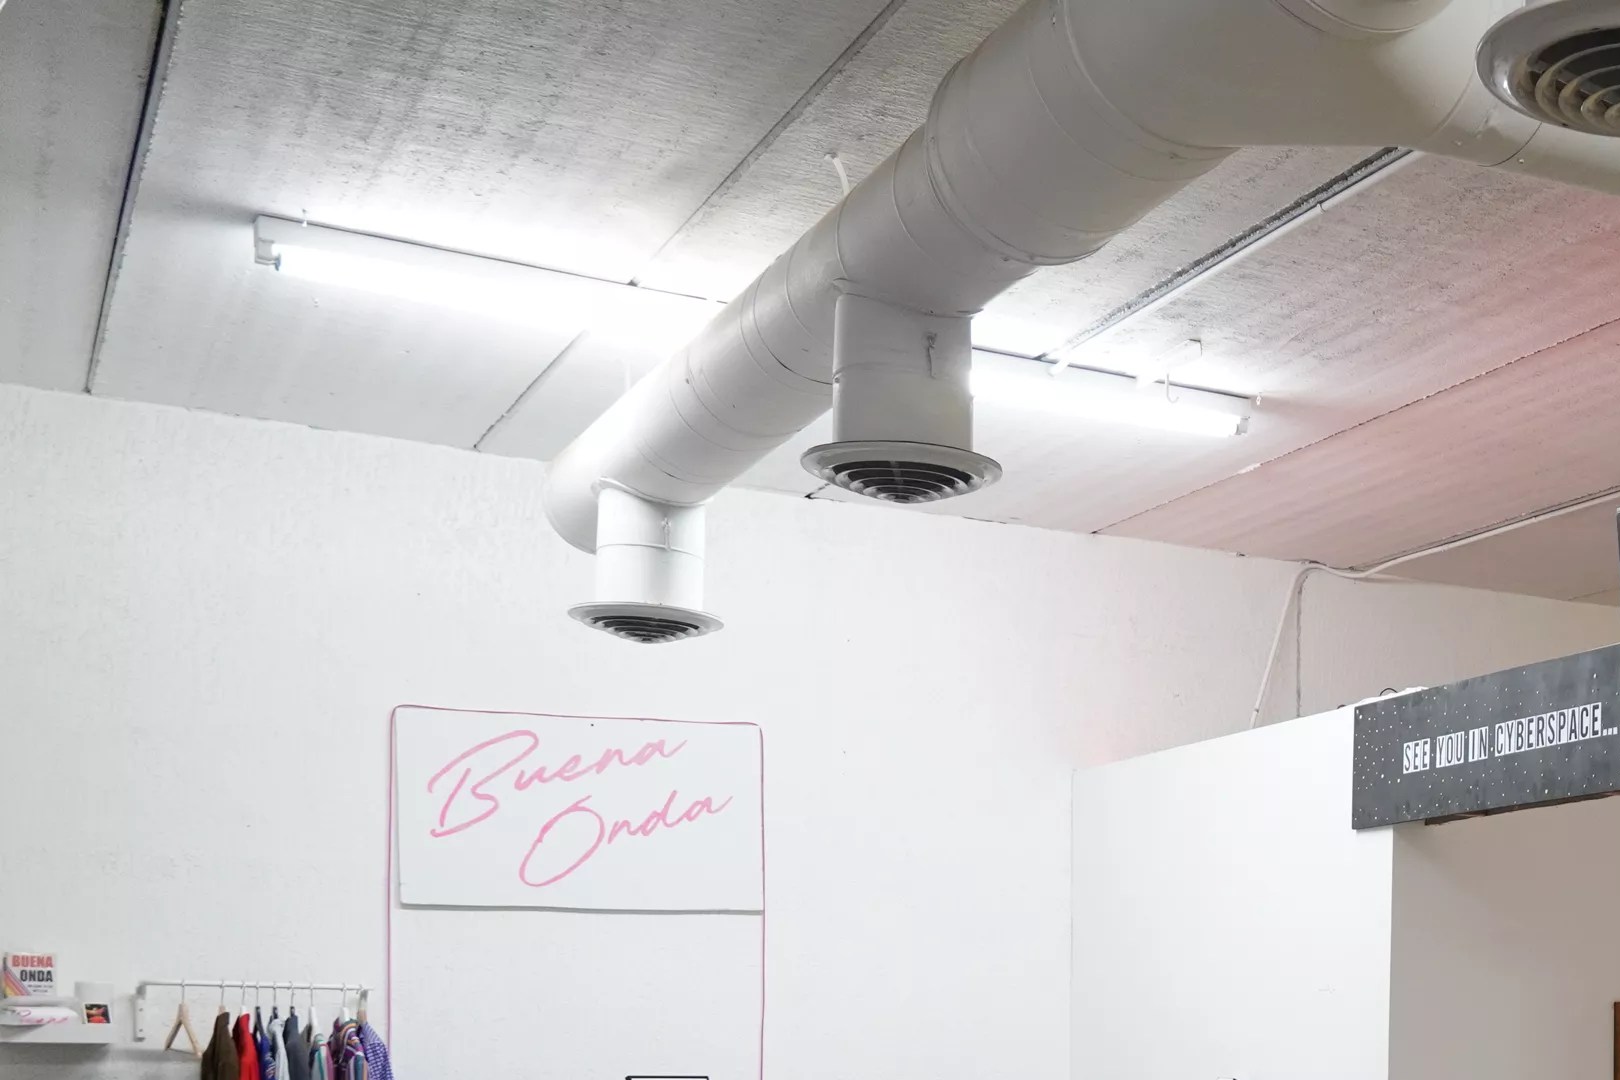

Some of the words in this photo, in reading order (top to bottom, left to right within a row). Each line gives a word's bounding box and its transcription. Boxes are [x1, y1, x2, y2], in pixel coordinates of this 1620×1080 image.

[1404, 740, 1429, 772] SEE
[1437, 732, 1464, 767] YOU
[1470, 727, 1488, 760] IN
[427, 729, 687, 838] Buena
[518, 790, 733, 887] Onda
[12, 955, 53, 968] BUENA
[20, 970, 53, 982] ONDA
